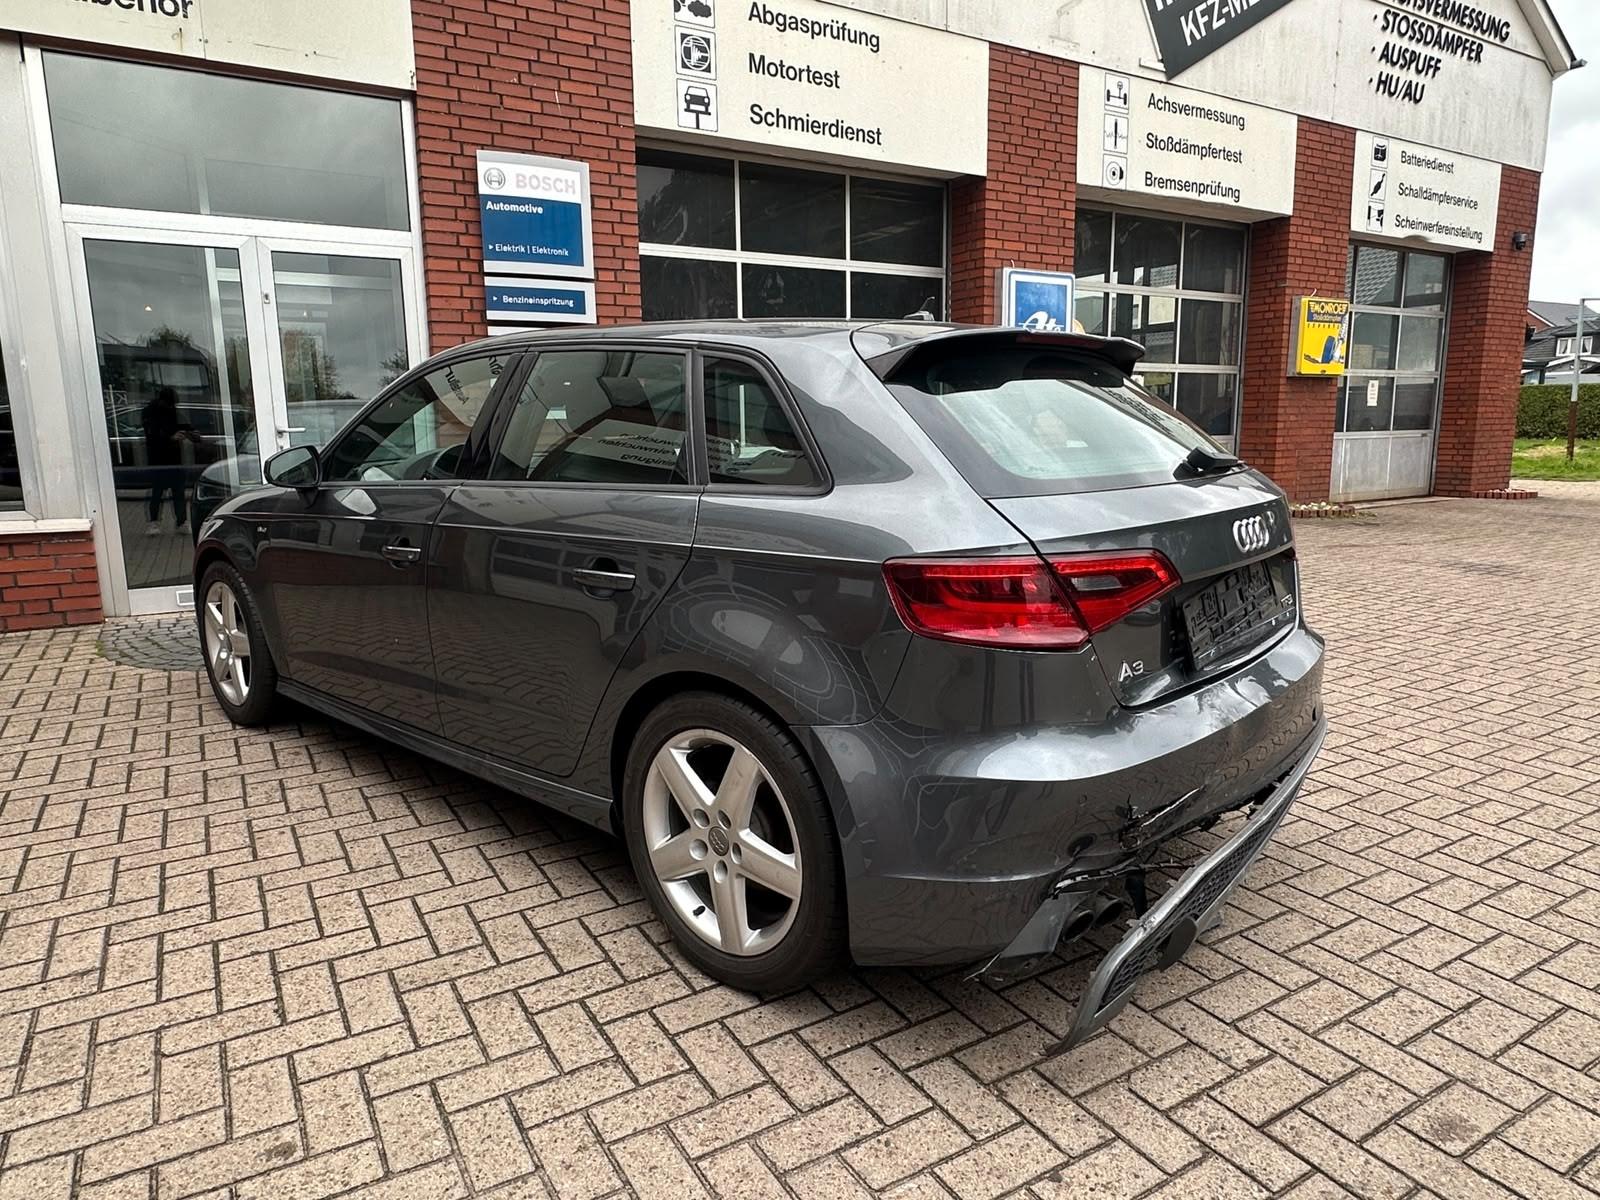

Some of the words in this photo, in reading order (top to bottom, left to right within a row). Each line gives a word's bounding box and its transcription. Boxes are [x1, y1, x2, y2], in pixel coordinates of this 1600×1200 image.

[748, 1, 880, 53] Abgasprüfung
[1380, 9, 1484, 63] STOSSDÄMPFER
[748, 52, 840, 89] Motortest
[1379, 41, 1442, 79] AUSPUFF
[1375, 71, 1425, 104] HU/AU
[750, 103, 882, 146] Schmierdienst
[1147, 92, 1245, 131] Achsvermessung
[1145, 132, 1243, 164] Stoßdämpfertest
[1400, 150, 1455, 174] Batteriedienst
[515, 173, 576, 195] BOSCH
[1144, 171, 1241, 203] Bremsenprüfung
[1398, 182, 1479, 210] Schalldämpferservice
[486, 200, 544, 215] Automotive
[1394, 214, 1483, 243] Scheinwerfereinstellung
[495, 243, 525, 253] Elektrik
[532, 246, 569, 257] Elektronik
[502, 295, 574, 307] Benzineinspritzung
[1118, 659, 1145, 682] A3
